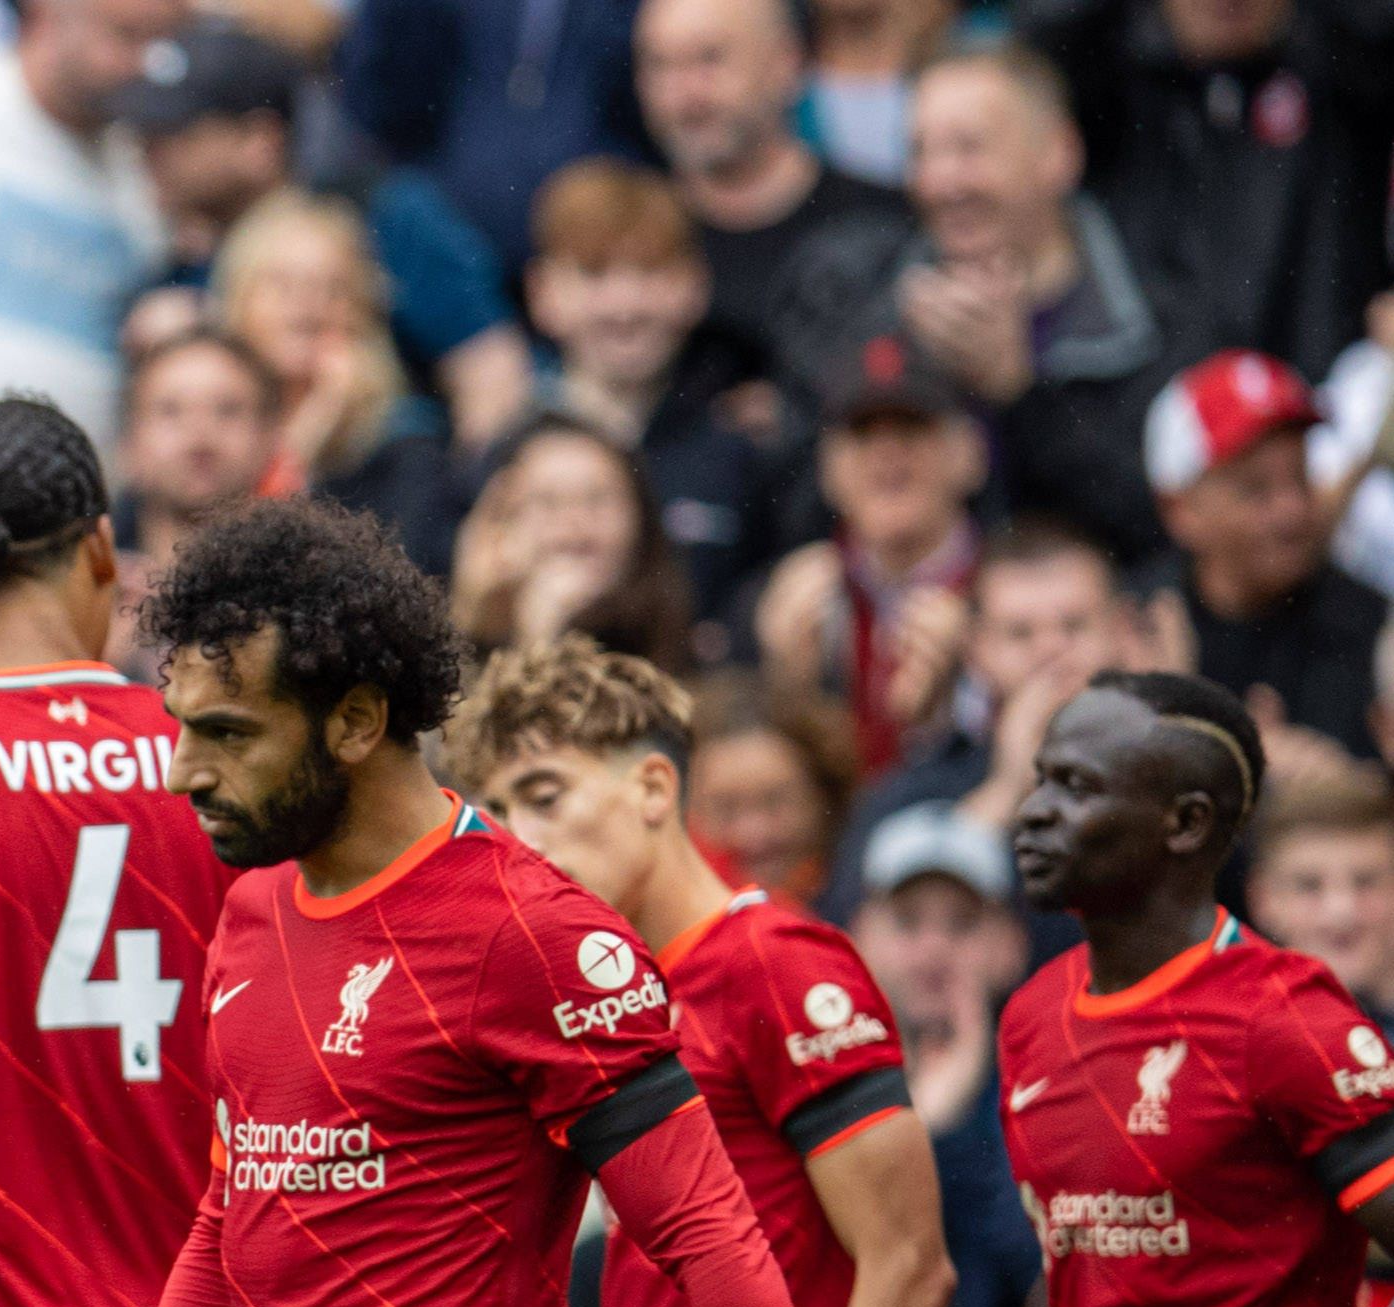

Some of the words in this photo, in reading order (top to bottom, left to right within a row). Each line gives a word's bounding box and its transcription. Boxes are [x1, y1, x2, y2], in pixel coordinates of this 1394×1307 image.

[36, 823, 184, 1081] 4
[551, 971, 669, 1039] Expedi
[234, 1116, 371, 1157] standard
[234, 1154, 386, 1192] chartered
[1049, 1188, 1175, 1226] tandard
